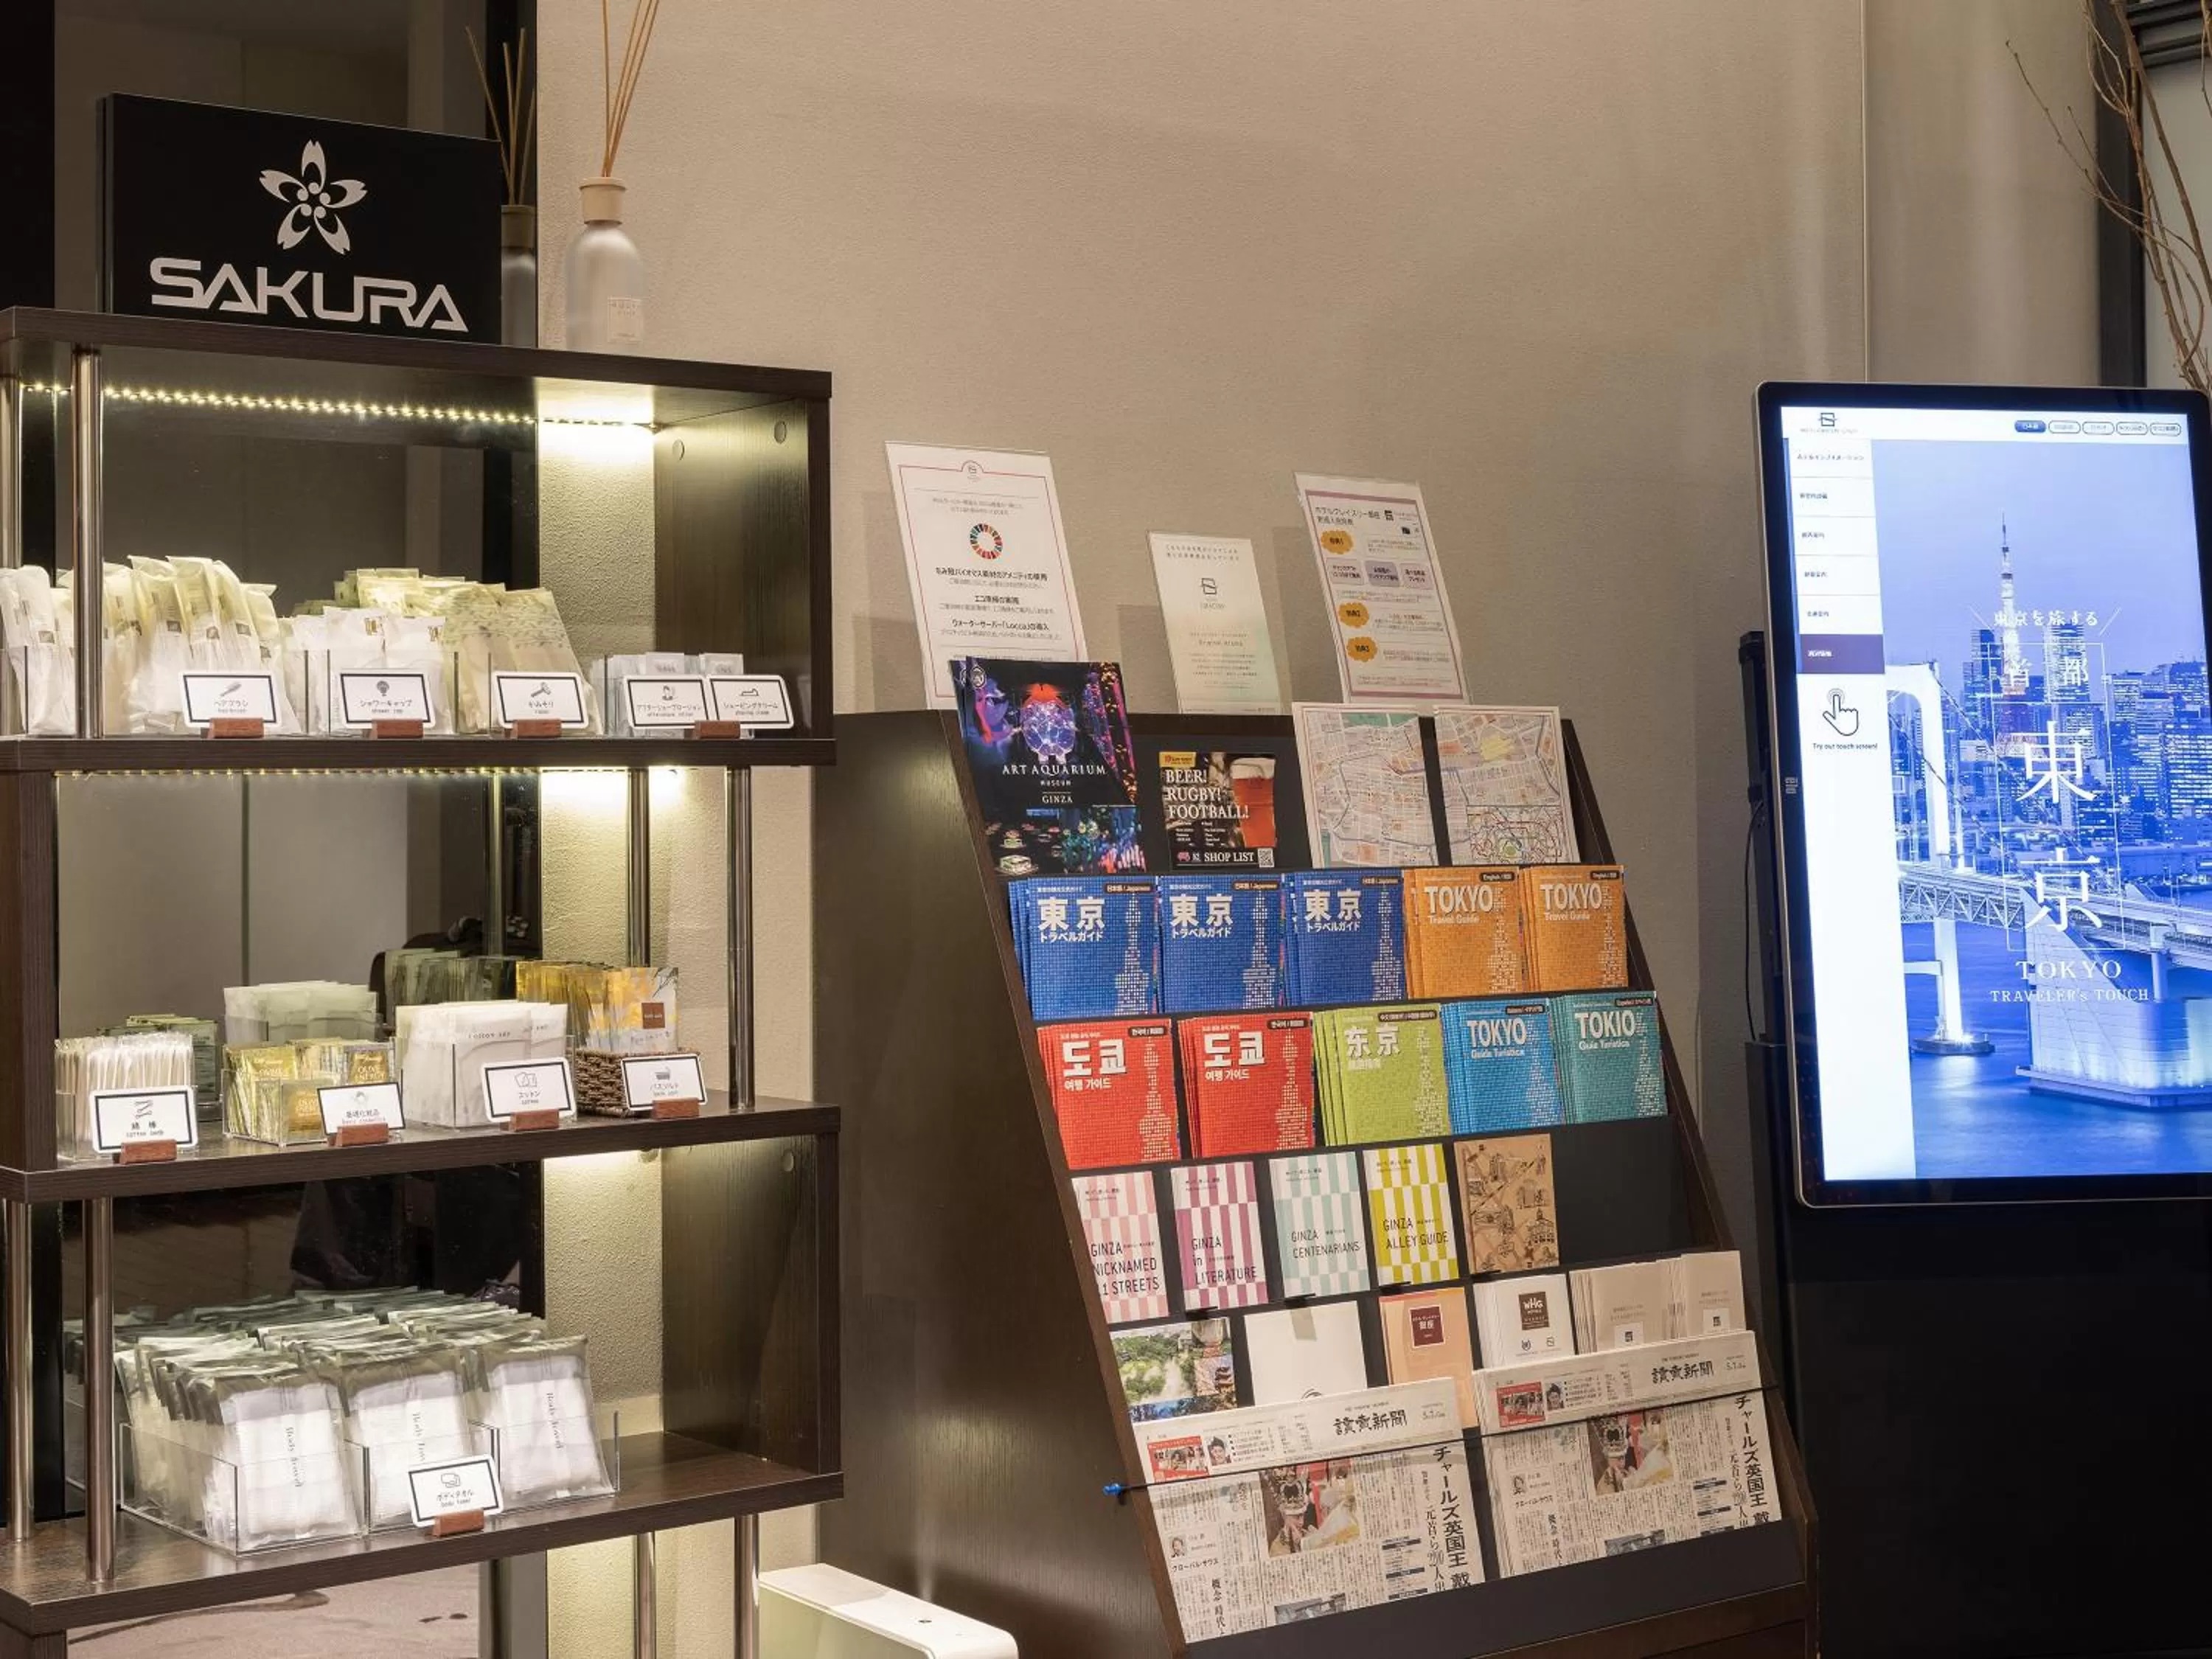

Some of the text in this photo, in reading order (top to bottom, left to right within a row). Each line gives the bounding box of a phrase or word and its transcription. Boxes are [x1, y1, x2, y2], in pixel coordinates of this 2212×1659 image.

[150, 256, 469, 333] SAKURA
[1993, 609, 2098, 627] 東京を旅する
[360, 699, 413, 707] シャワーキャップ
[1813, 742, 1823, 751] Try
[1002, 764, 1107, 776] ART AQUARIUM
[1165, 769, 1207, 784] BEER!
[1042, 794, 1074, 804] GINZA
[1166, 787, 1222, 802] RUGBY!
[1168, 804, 1251, 820] FOOTBALL!
[2011, 720, 2104, 933] 東京
[1204, 852, 1231, 863] SHOP
[1234, 852, 1254, 862] LIST
[1303, 888, 1363, 922] 東京
[1425, 884, 1494, 915] TOKYO
[1540, 883, 1603, 911] TOKYO
[1037, 896, 1105, 931] 東京
[1169, 893, 1234, 928] 東京
[1545, 911, 1590, 921] Travel Guide
[1429, 914, 1480, 924] Travel Guide
[1172, 927, 1232, 939] トラベルガイド
[1307, 922, 1361, 933] トラベルガイド
[1040, 931, 1105, 944] トラベルガイド
[2016, 961, 2121, 980] TOKYO
[1991, 988, 2149, 1003] TRAVELER's TOUCH
[1574, 1009, 1635, 1039] TOKIO
[1344, 1023, 1401, 1057] 东京
[1467, 1018, 1527, 1048] TOKYO
[1062, 1038, 1127, 1077] 도쿄
[1204, 1031, 1265, 1068] 도쿄
[1206, 1068, 1251, 1082] 여행 가이드
[1064, 1077, 1112, 1091] 여행 가이드
[518, 1091, 541, 1099] コットン
[1383, 1218, 1413, 1231] GINZA
[1291, 1228, 1319, 1242] GINZA
[1386, 1231, 1450, 1250] ALLEY GUIDE
[1091, 1241, 1123, 1257] GINZA
[1192, 1237, 1222, 1251] GINZA
[1293, 1241, 1360, 1259] CENTENARIANS
[1193, 1254, 1203, 1267] in
[1195, 1266, 1257, 1285] LITERATURE
[1112, 1276, 1160, 1295] STREETS
[1523, 1298, 1544, 1310] WHG
[1734, 1395, 1768, 1508] チャールズ英国王
[1433, 1447, 1468, 1568] チャールズ英国王
